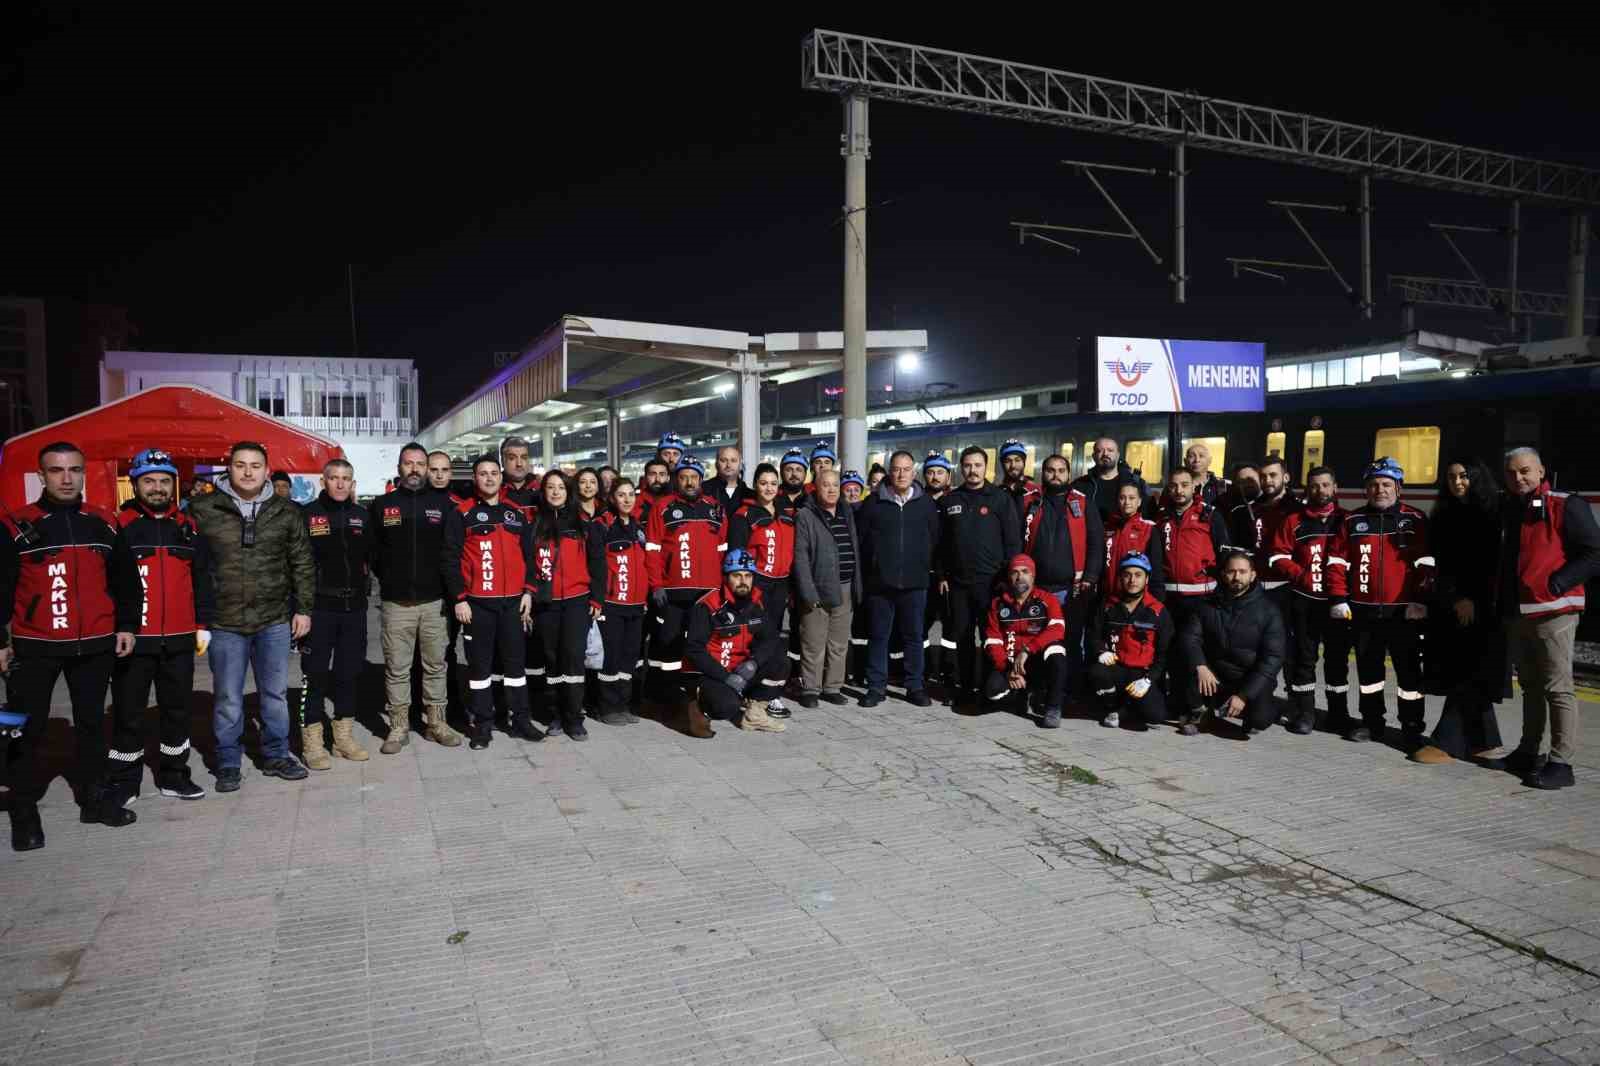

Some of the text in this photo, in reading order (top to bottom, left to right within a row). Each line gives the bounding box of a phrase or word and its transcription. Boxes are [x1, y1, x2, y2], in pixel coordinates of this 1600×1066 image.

[1109, 392, 1149, 406] TCDD
[1188, 365, 1260, 388] MENEMEN
[479, 541, 495, 591] MAKUR
[678, 532, 691, 580] MAKUR
[765, 529, 776, 573] MAKUR
[1310, 544, 1323, 592] MAKUR
[1359, 544, 1372, 593] MAKUR
[48, 563, 69, 629] MAKUR
[616, 555, 629, 601] MAKUR
